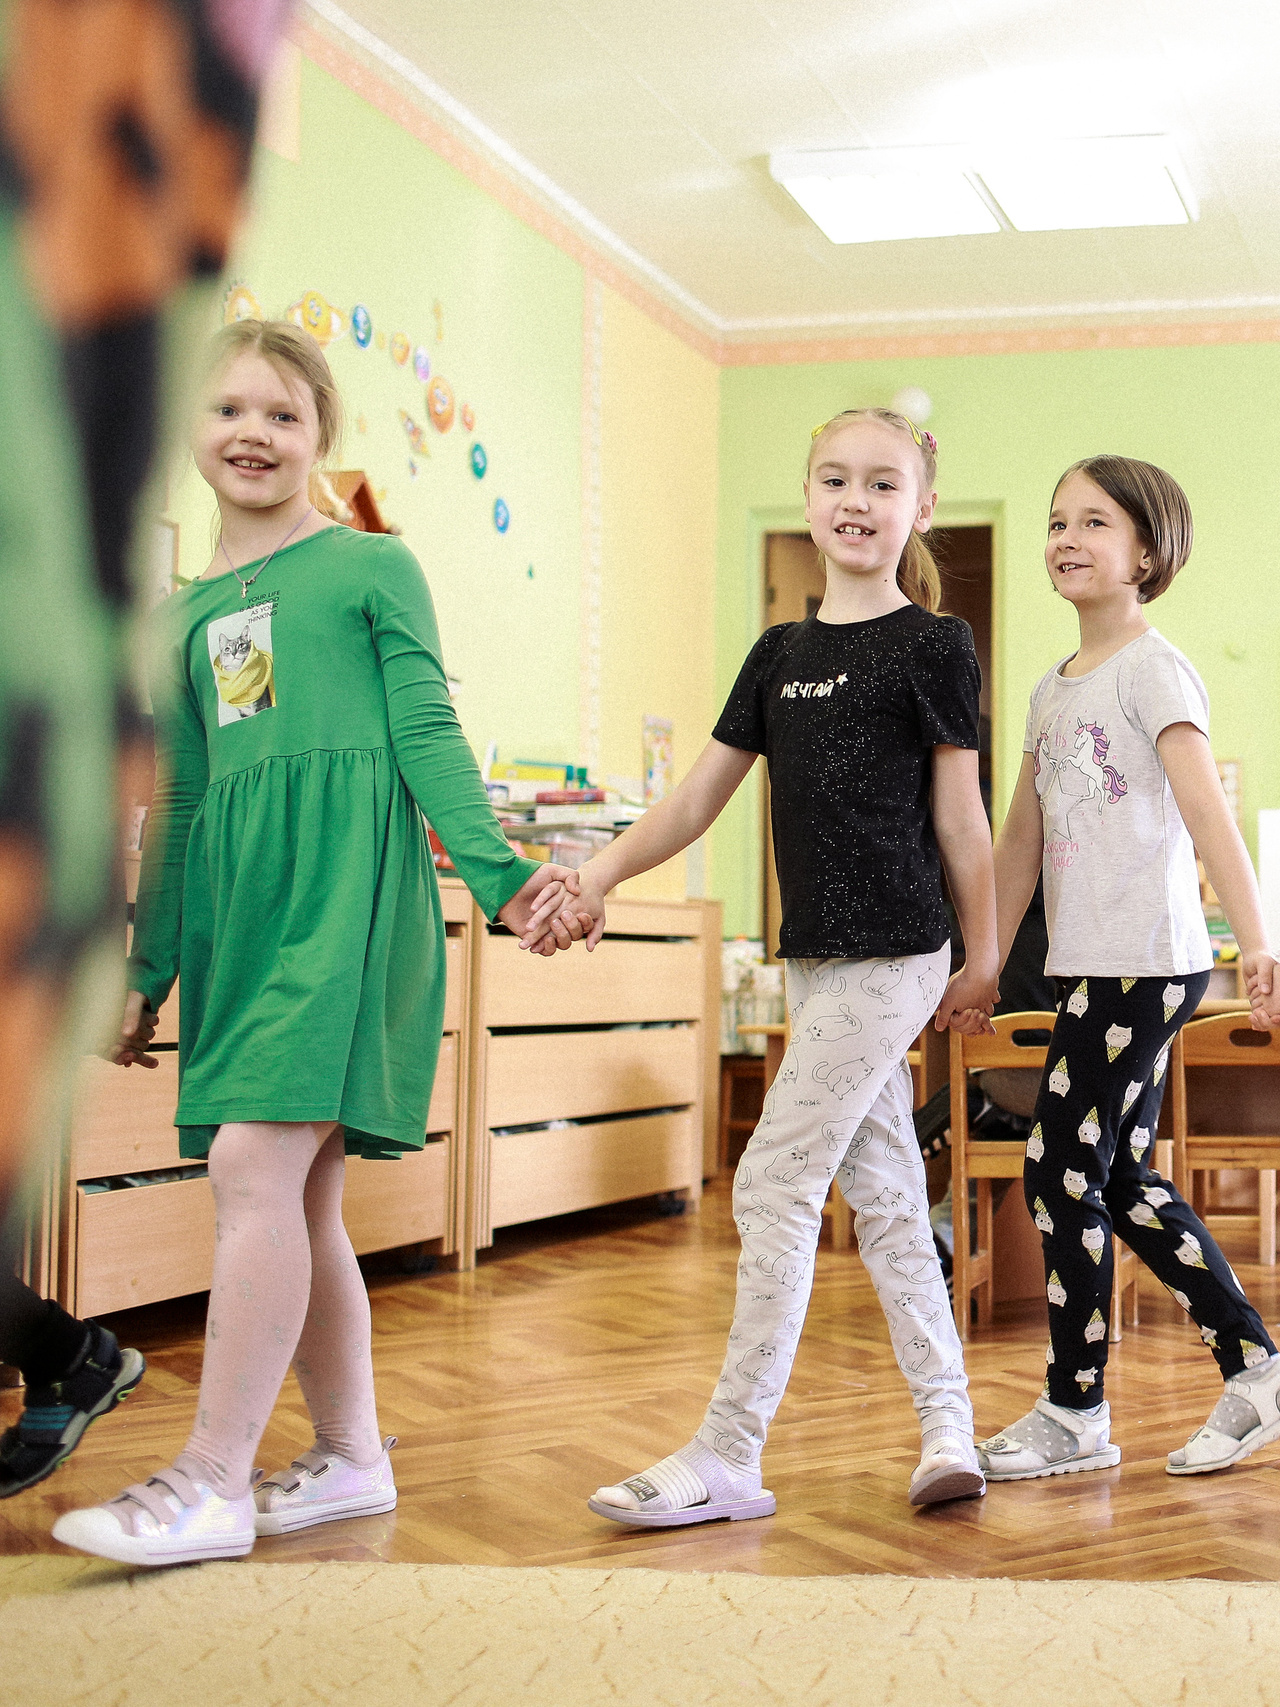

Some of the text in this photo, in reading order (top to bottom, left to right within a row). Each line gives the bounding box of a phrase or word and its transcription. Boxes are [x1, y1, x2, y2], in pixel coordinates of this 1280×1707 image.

[248, 594, 266, 603] YOUR
[260, 603, 278, 612] YOUR
[248, 610, 277, 624] THINKING
[780, 678, 835, 699] МЕЧТАЙ
